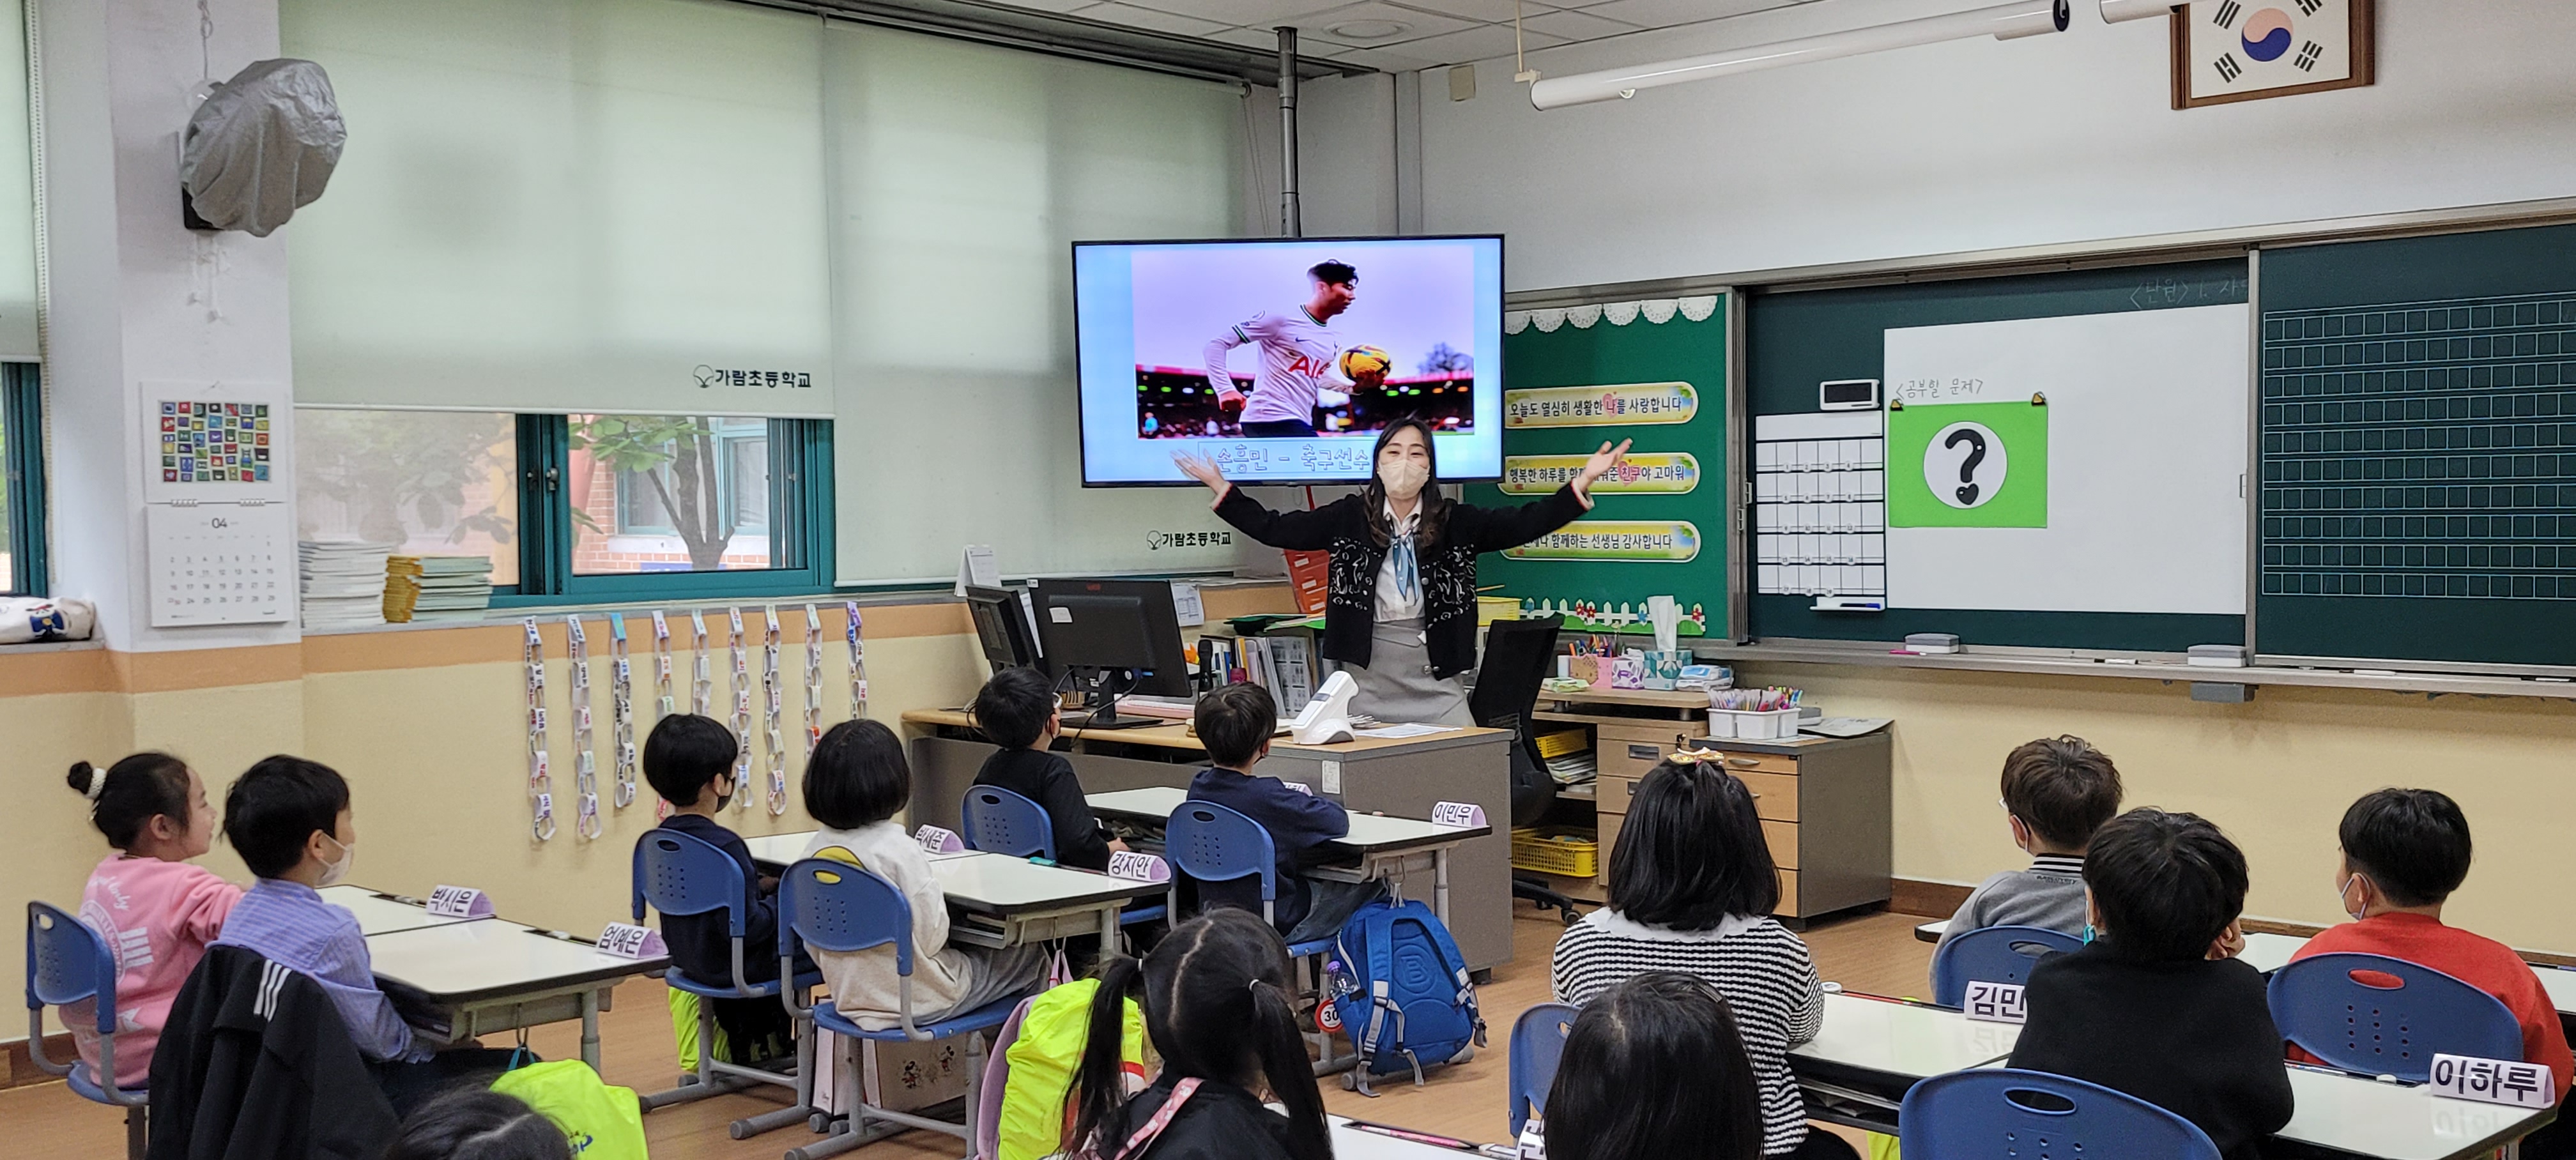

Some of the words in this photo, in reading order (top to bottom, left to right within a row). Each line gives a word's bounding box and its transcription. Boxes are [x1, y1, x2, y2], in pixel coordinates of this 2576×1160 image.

[715, 369, 811, 388] 가람초등학교
[1510, 402, 1538, 418] 오늘도
[1542, 401, 1570, 416] 열심히
[1574, 400, 1602, 416] 생활한
[1606, 399, 1625, 414] 나를
[1629, 397, 1681, 413] 사랑합니다
[1217, 444, 1268, 473] 손흥민
[1301, 443, 1370, 471] 축구선수
[1510, 468, 1537, 484] 행복한
[1539, 468, 1565, 483] 하루를
[1622, 467, 1651, 482] 친구야
[1654, 466, 1684, 481] 고마워
[211, 517, 227, 528] 04
[1162, 531, 1231, 547] 가람초등학교
[1551, 533, 1589, 549] 함께하는
[1591, 534, 1619, 549] 선생님
[1622, 534, 1673, 550] 감사합니다
[1435, 804, 1471, 825] 이민우
[1112, 853, 1151, 878] 강지안
[431, 888, 472, 913] 박시은
[1324, 1011, 1339, 1022] 30
[2435, 1060, 2538, 1101] 이하루
